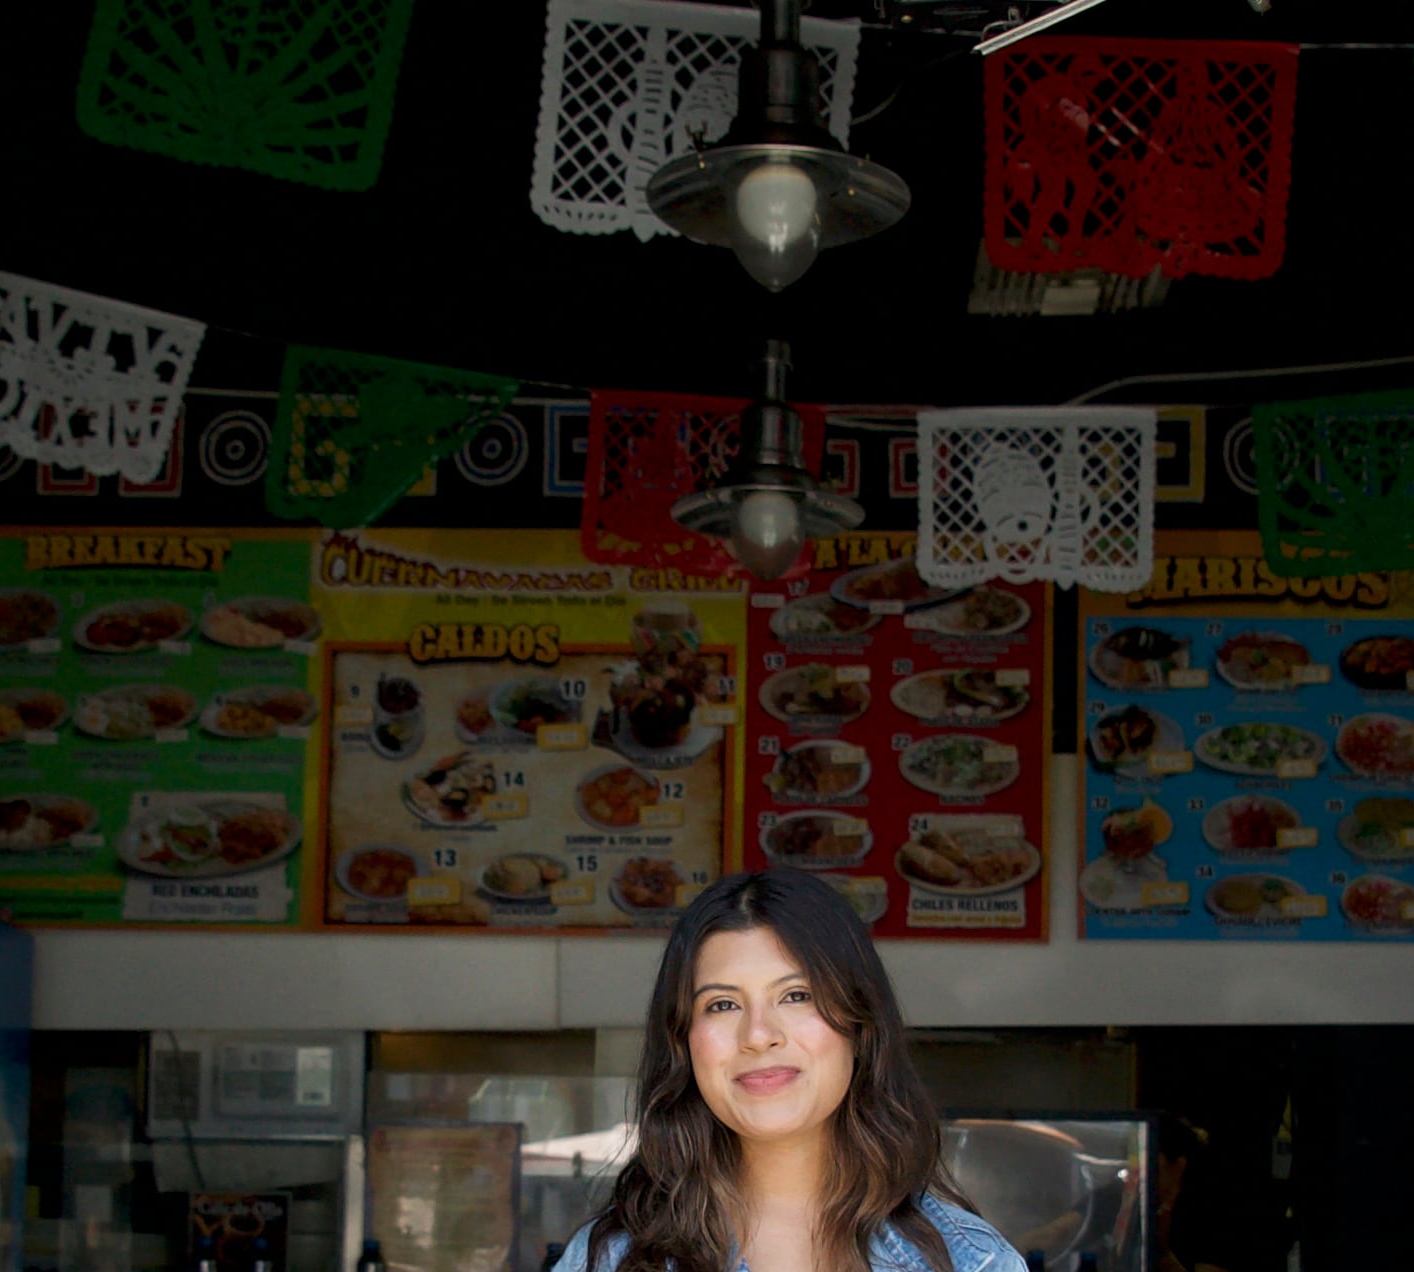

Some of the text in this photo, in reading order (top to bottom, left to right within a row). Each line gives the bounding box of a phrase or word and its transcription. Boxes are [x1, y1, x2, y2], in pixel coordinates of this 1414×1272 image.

[25, 536, 230, 571] BREAKFAST
[409, 623, 561, 667] CALDOS
[561, 678, 585, 698] 10
[504, 771, 525, 788] 14
[664, 784, 683, 799] 12
[912, 819, 929, 832] 24
[435, 851, 456, 867] 13
[577, 855, 598, 872] 15
[912, 900, 1019, 911] CHILES RELLENOS
